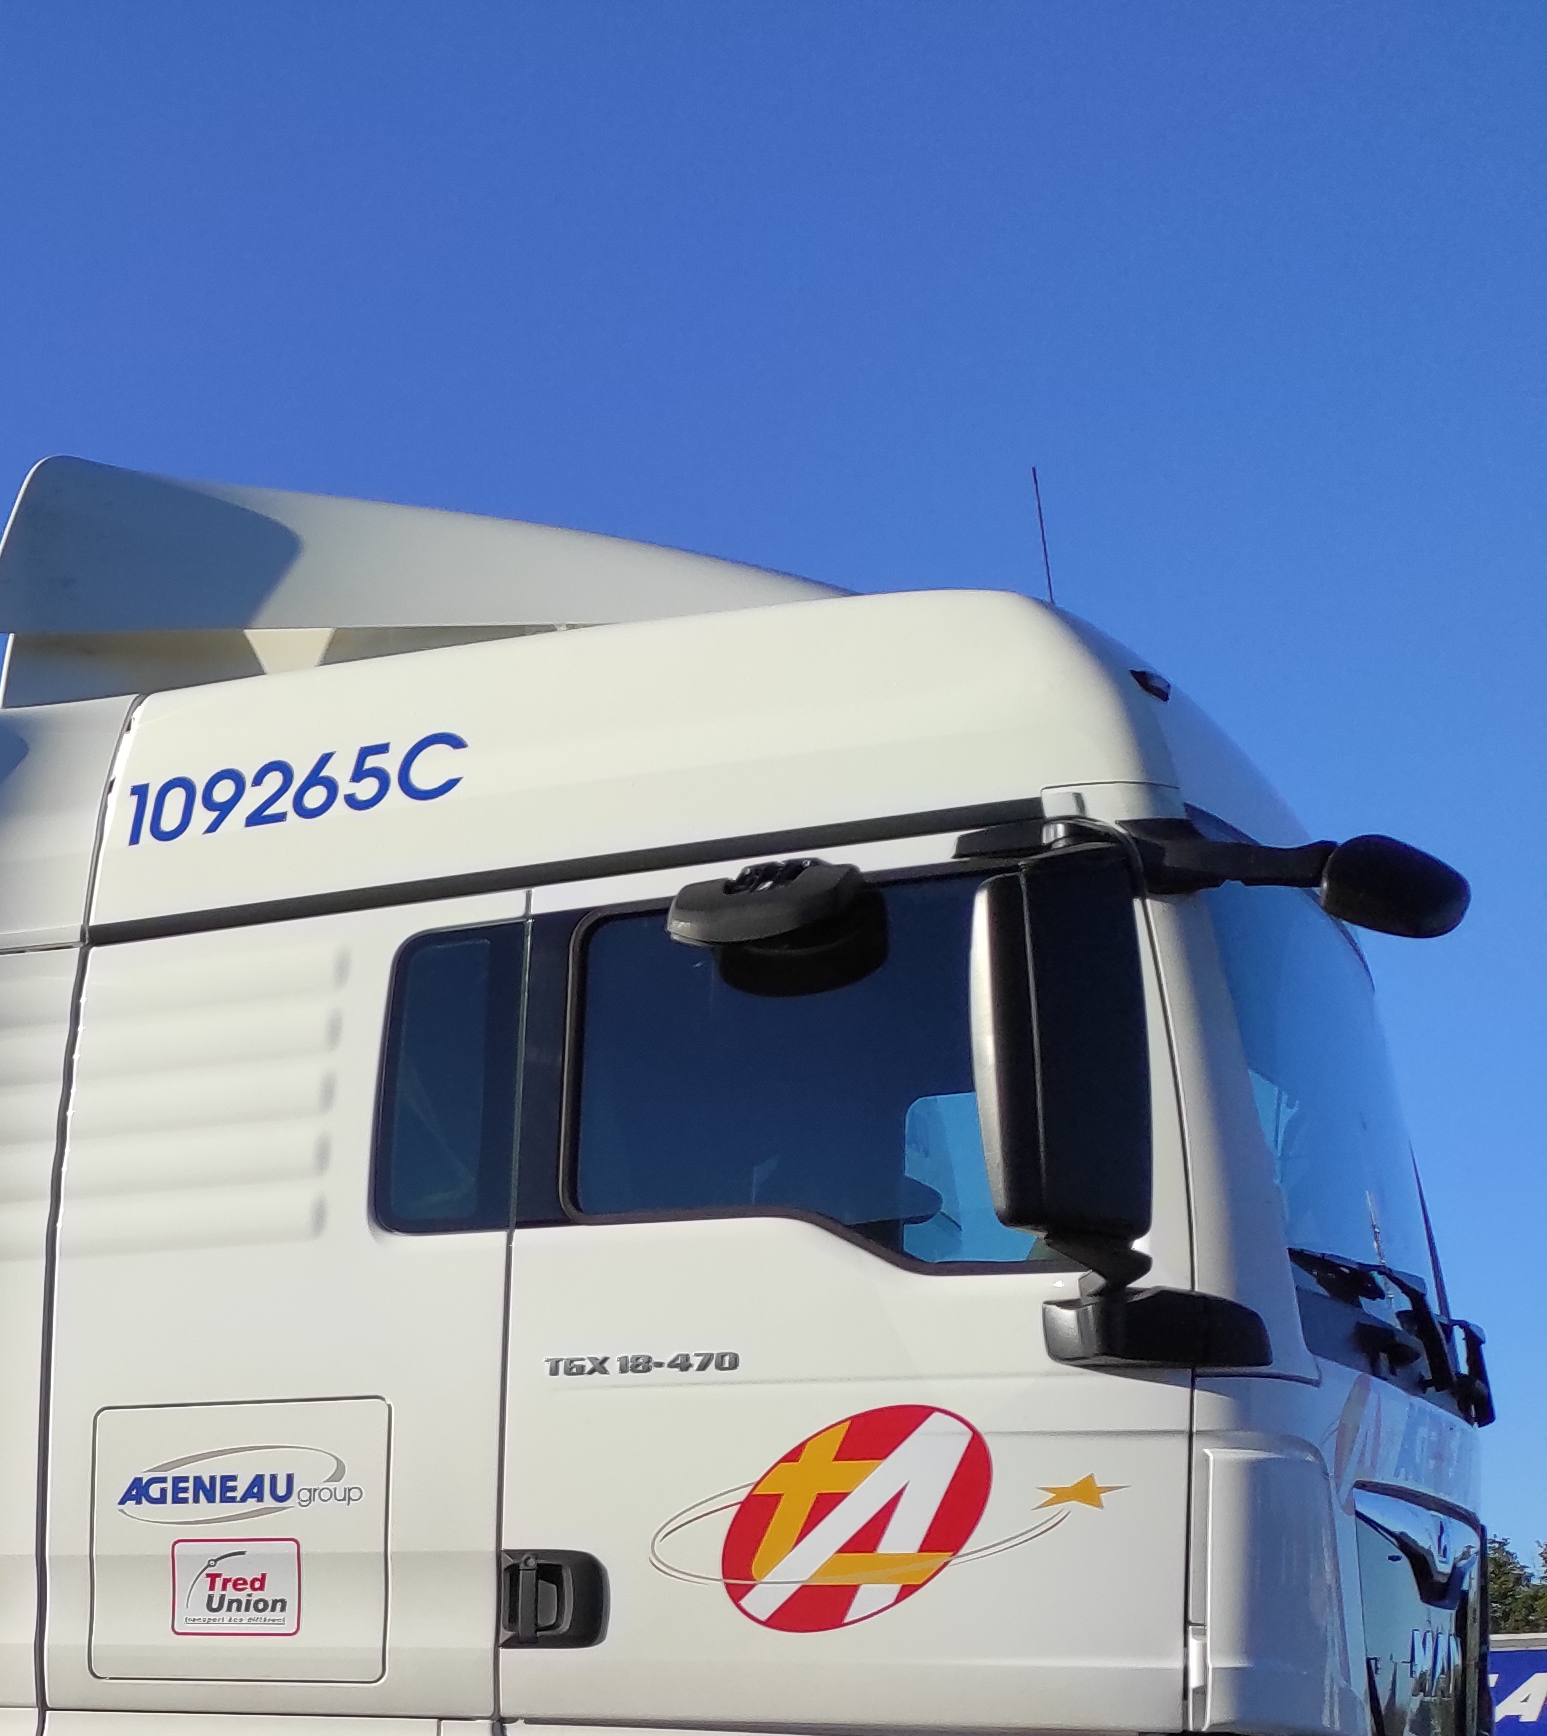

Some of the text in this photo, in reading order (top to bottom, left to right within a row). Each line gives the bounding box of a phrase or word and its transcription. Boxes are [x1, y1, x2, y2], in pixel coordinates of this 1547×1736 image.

[128, 731, 469, 846] 109265C
[617, 1352, 740, 1374] 18-470
[117, 1472, 364, 1508] AGENEAU group
[205, 1572, 267, 1592] Tred
[206, 1592, 287, 1613] Union
